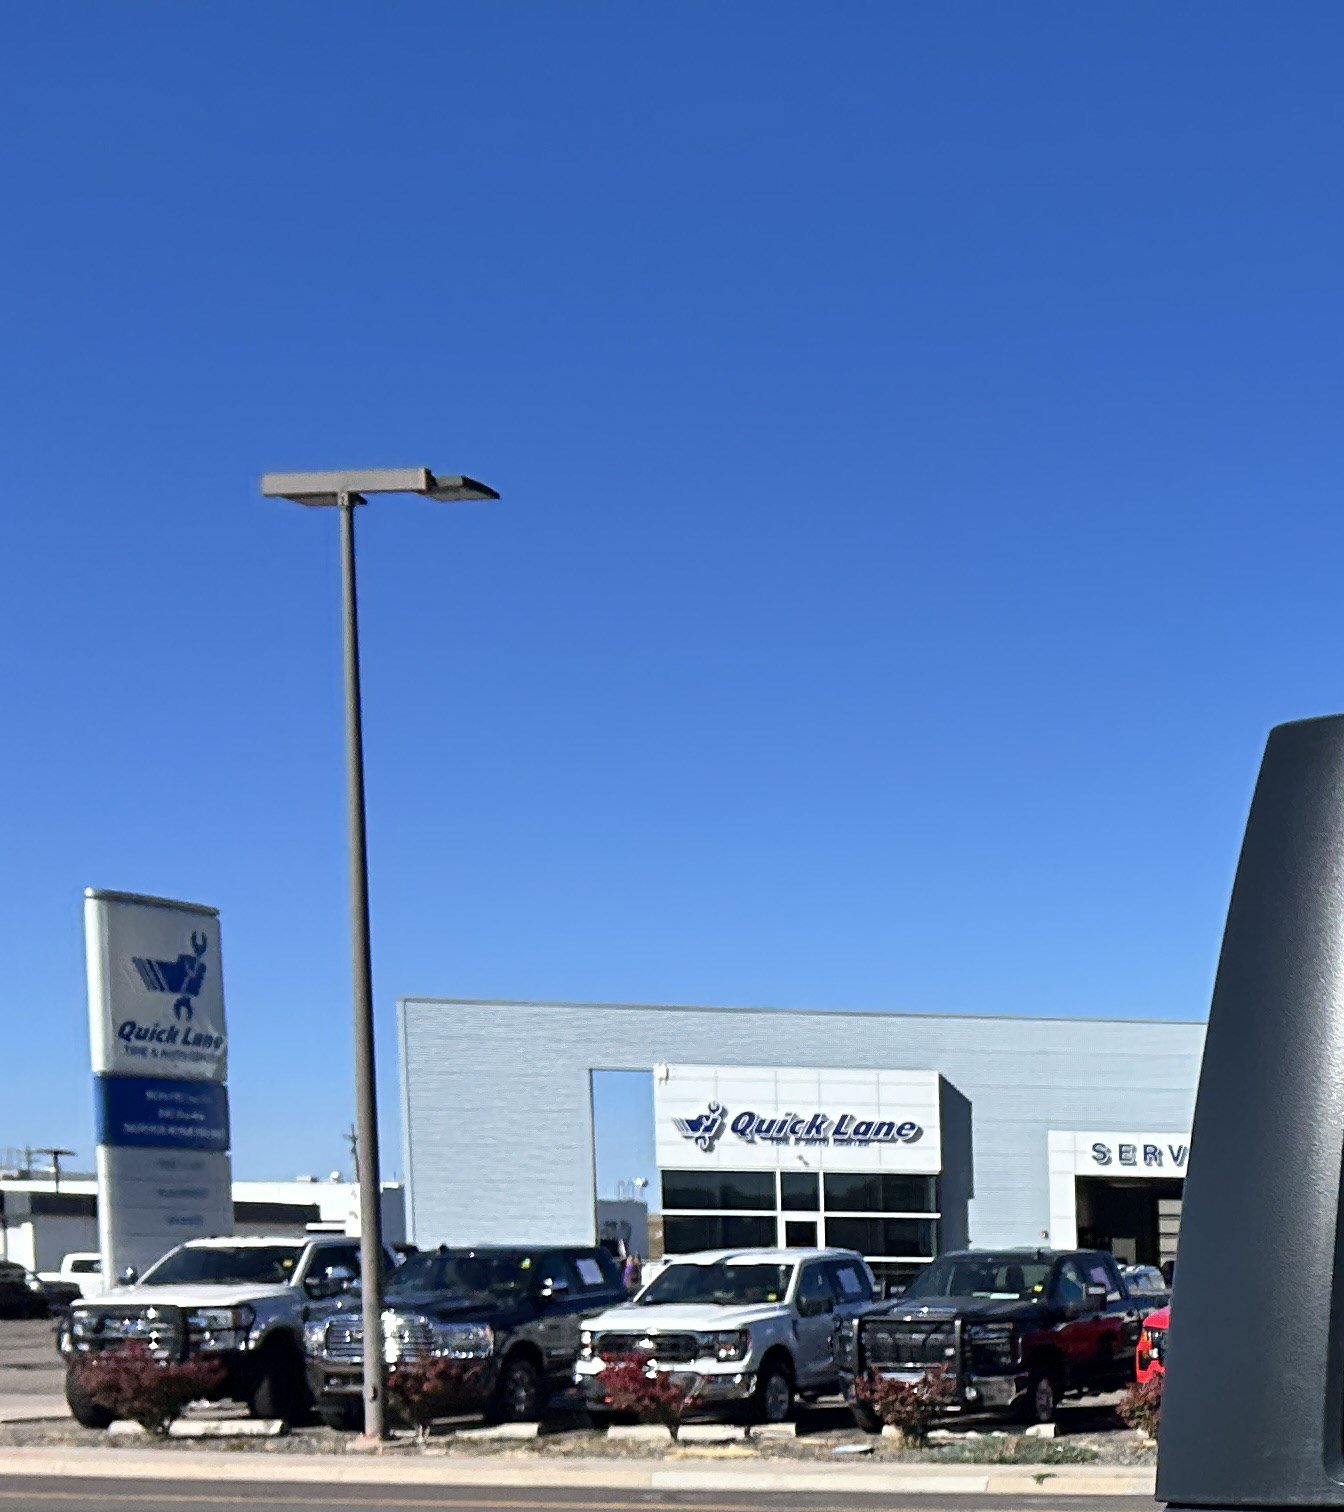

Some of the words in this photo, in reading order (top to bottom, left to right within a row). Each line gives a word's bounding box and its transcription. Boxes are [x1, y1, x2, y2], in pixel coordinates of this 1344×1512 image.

[730, 1111, 828, 1138] Quick
[831, 1113, 920, 1139] Lane
[1091, 1142, 1186, 1164] SERV
